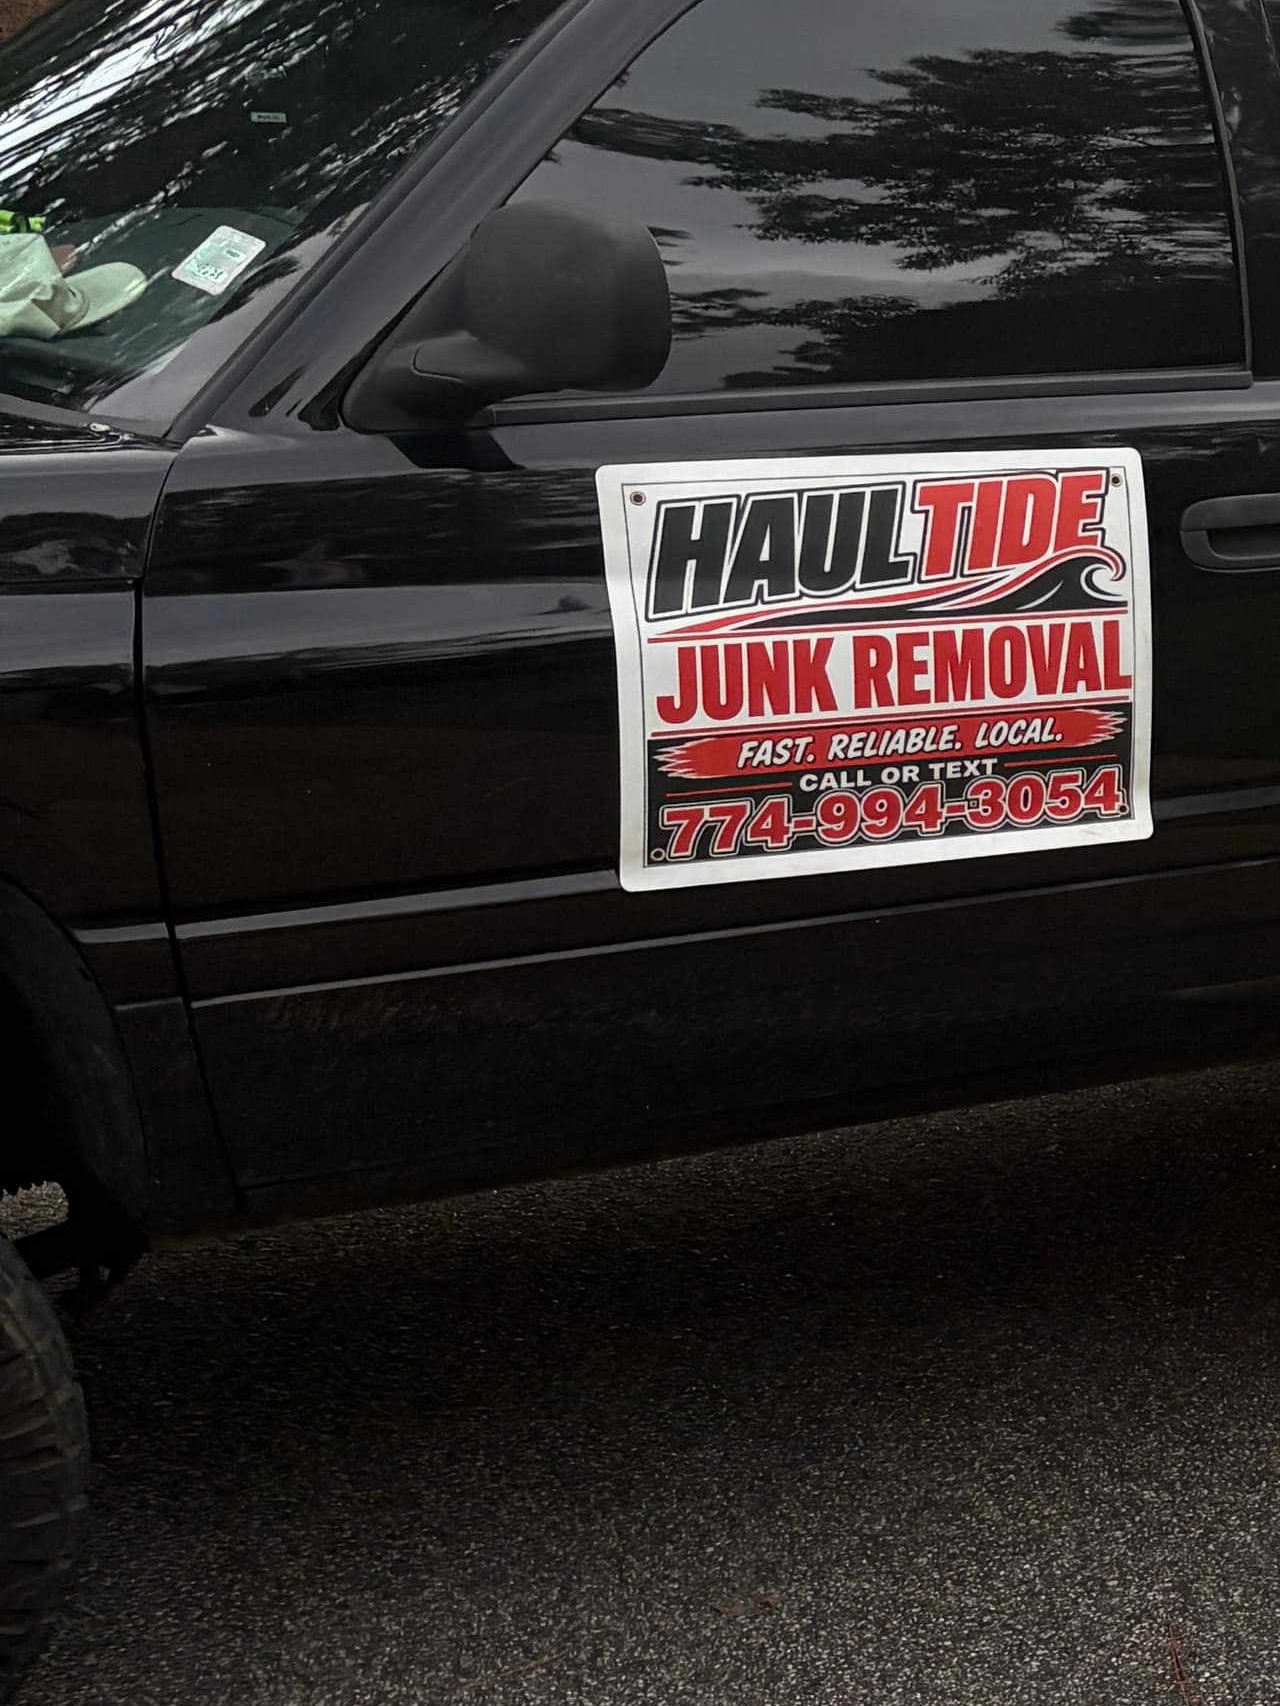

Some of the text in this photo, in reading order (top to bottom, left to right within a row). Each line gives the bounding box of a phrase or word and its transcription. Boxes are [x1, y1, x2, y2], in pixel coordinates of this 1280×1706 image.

[650, 471, 1107, 618] HAUL TIDE
[657, 620, 1132, 724] JUNK REMOVAL
[737, 716, 1064, 768] FAST. RELIABLE. LOCAL.
[799, 757, 998, 792] CALL OR TEXT
[662, 767, 1121, 858] 774-994-3054
